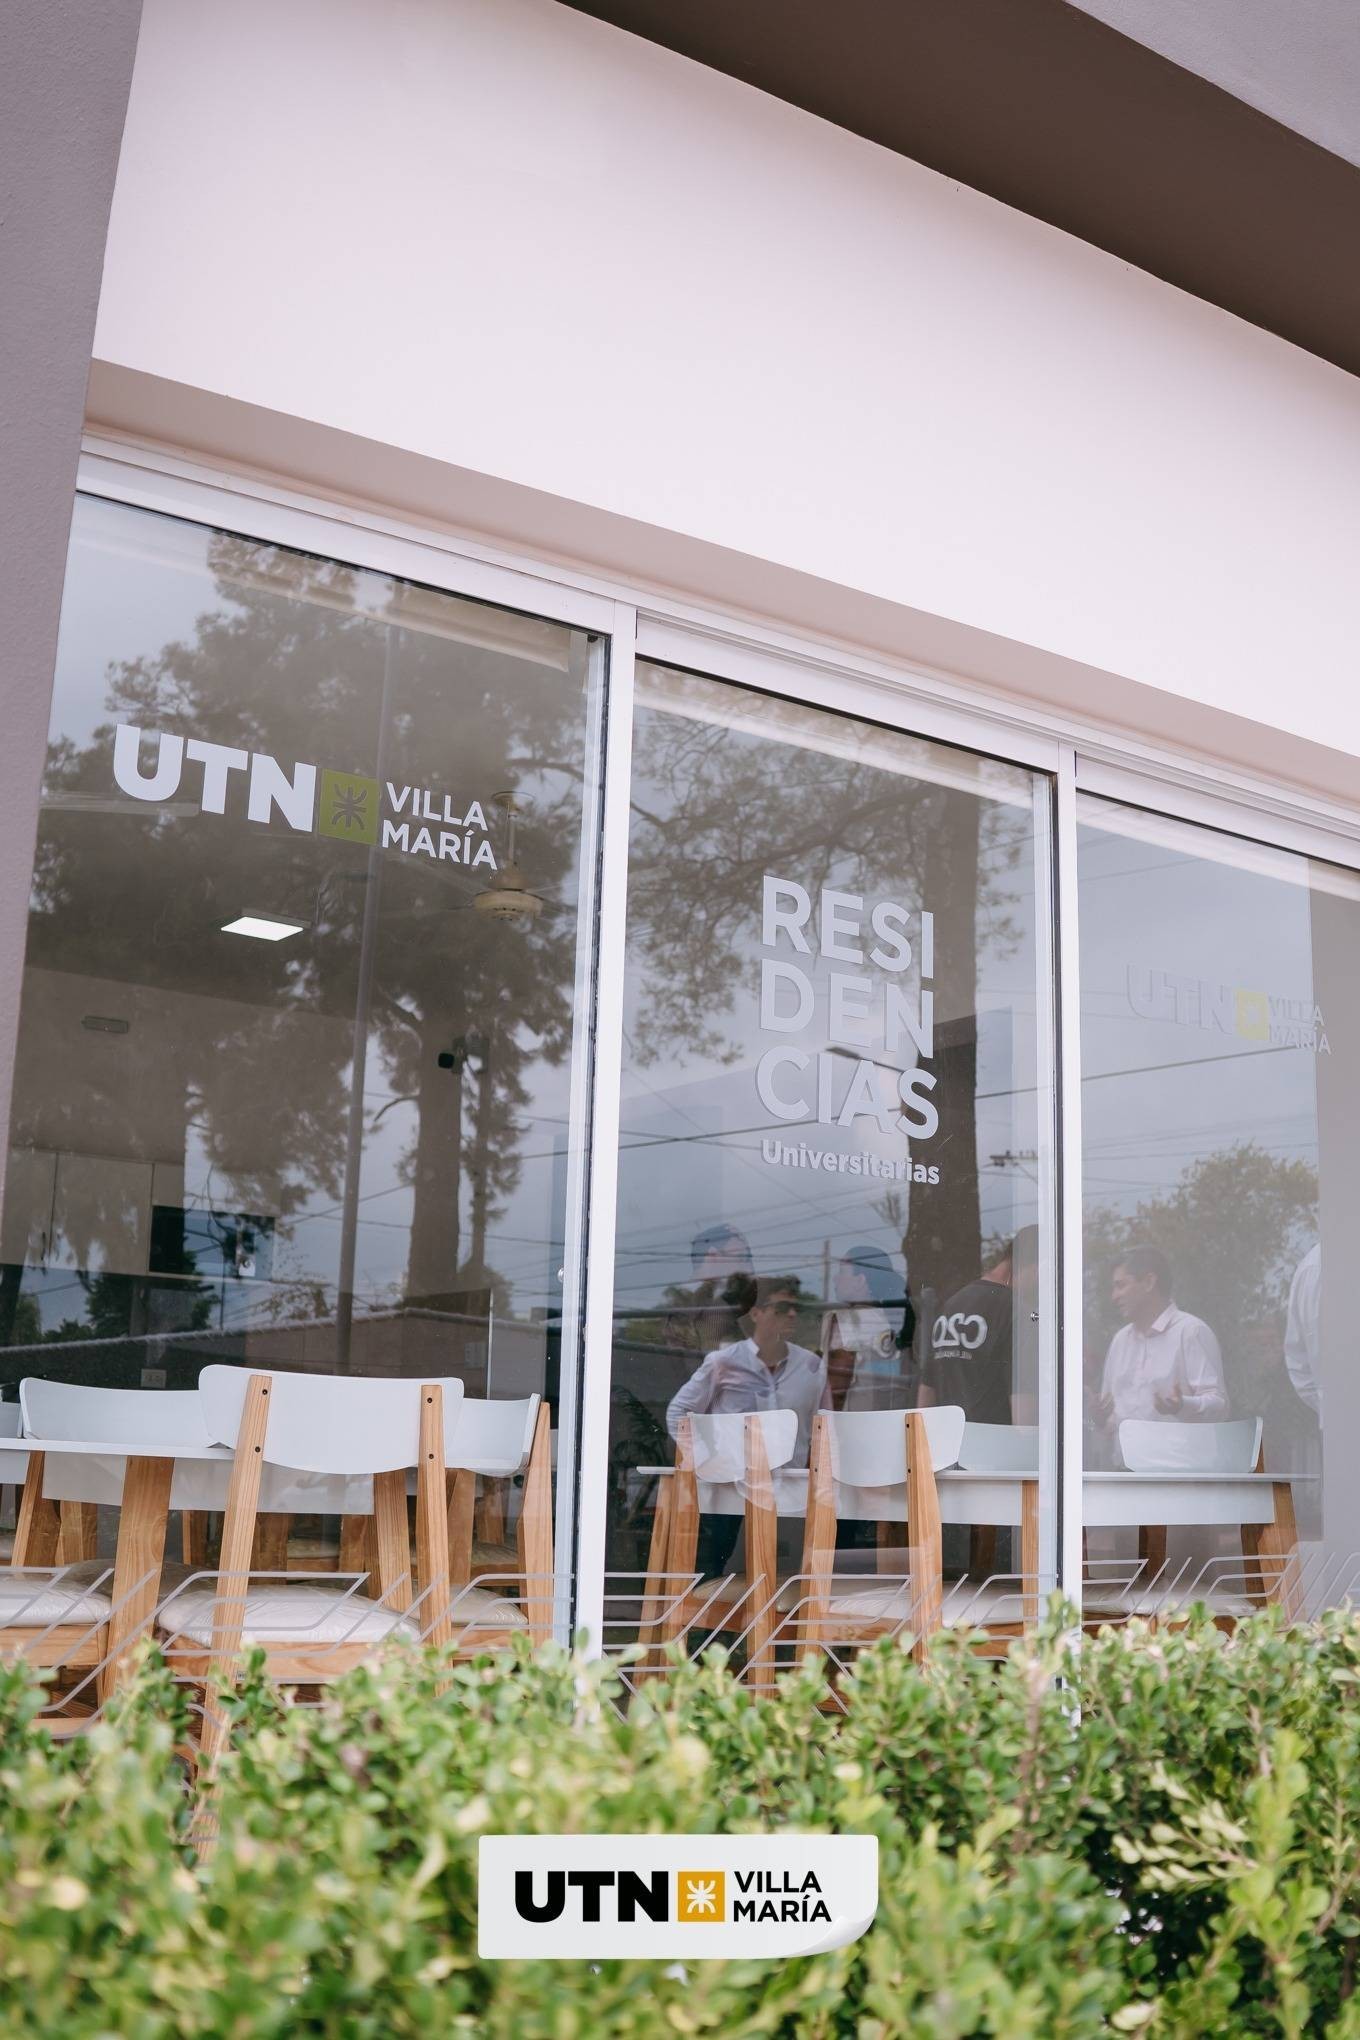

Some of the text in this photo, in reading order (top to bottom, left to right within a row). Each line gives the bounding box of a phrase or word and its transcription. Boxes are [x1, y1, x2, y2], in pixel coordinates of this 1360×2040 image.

[113, 723, 317, 832] UTN
[385, 781, 489, 831] VILLA
[381, 818, 498, 871] MARÍA
[762, 874, 934, 980] RESI
[760, 957, 934, 1060] DEN
[1125, 962, 1234, 1036] UTN
[1267, 995, 1325, 1027] VILLA
[755, 1044, 939, 1140] CIAS
[761, 1138, 940, 1186] Universitarias
